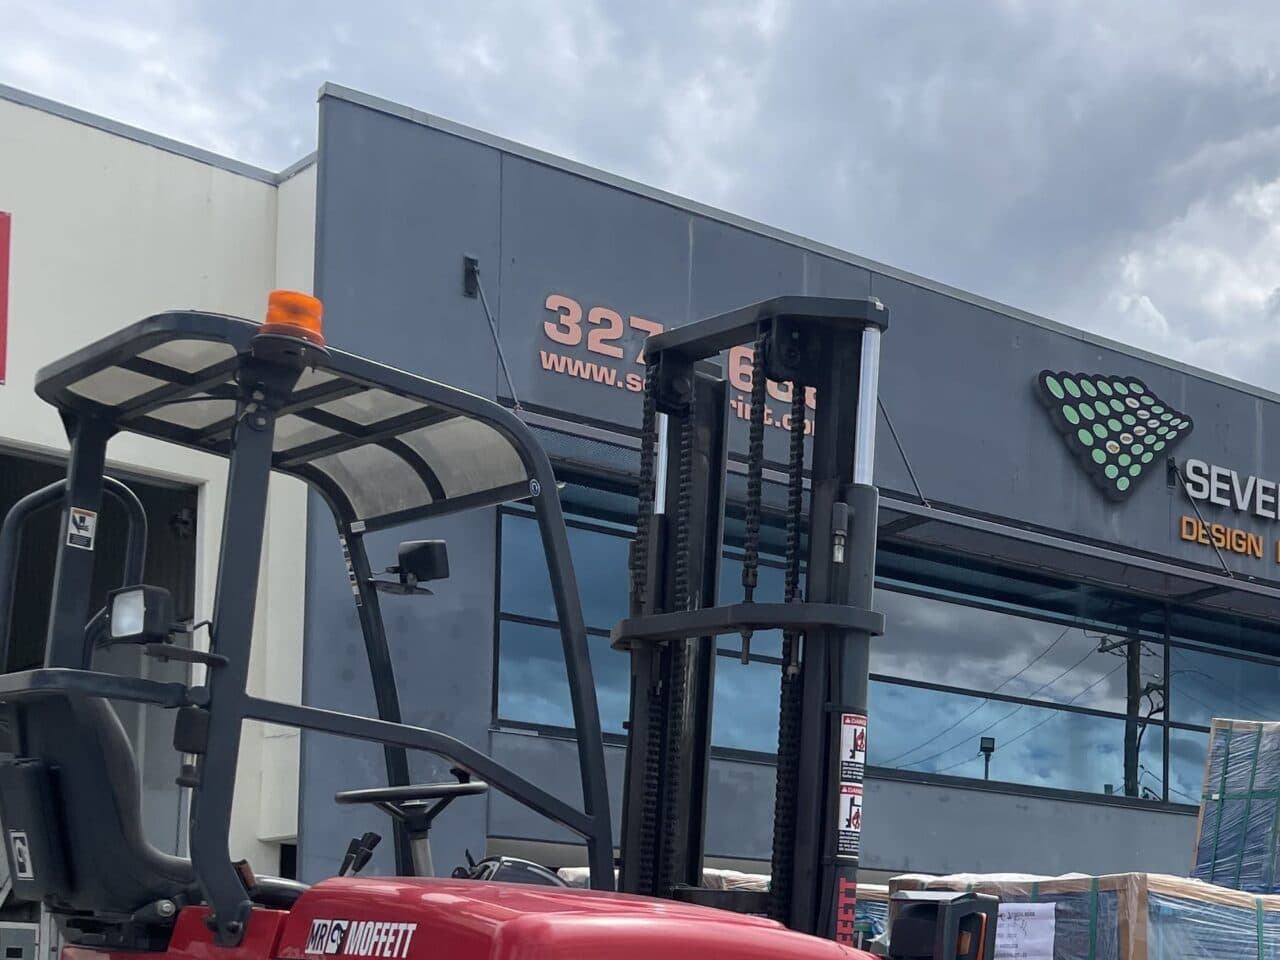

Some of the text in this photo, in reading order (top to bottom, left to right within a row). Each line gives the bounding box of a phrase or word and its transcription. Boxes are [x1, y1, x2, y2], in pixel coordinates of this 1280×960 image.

[543, 294, 664, 365] 327
[1180, 515, 1264, 558] DESIGN
[343, 921, 417, 958] MOFFETT
